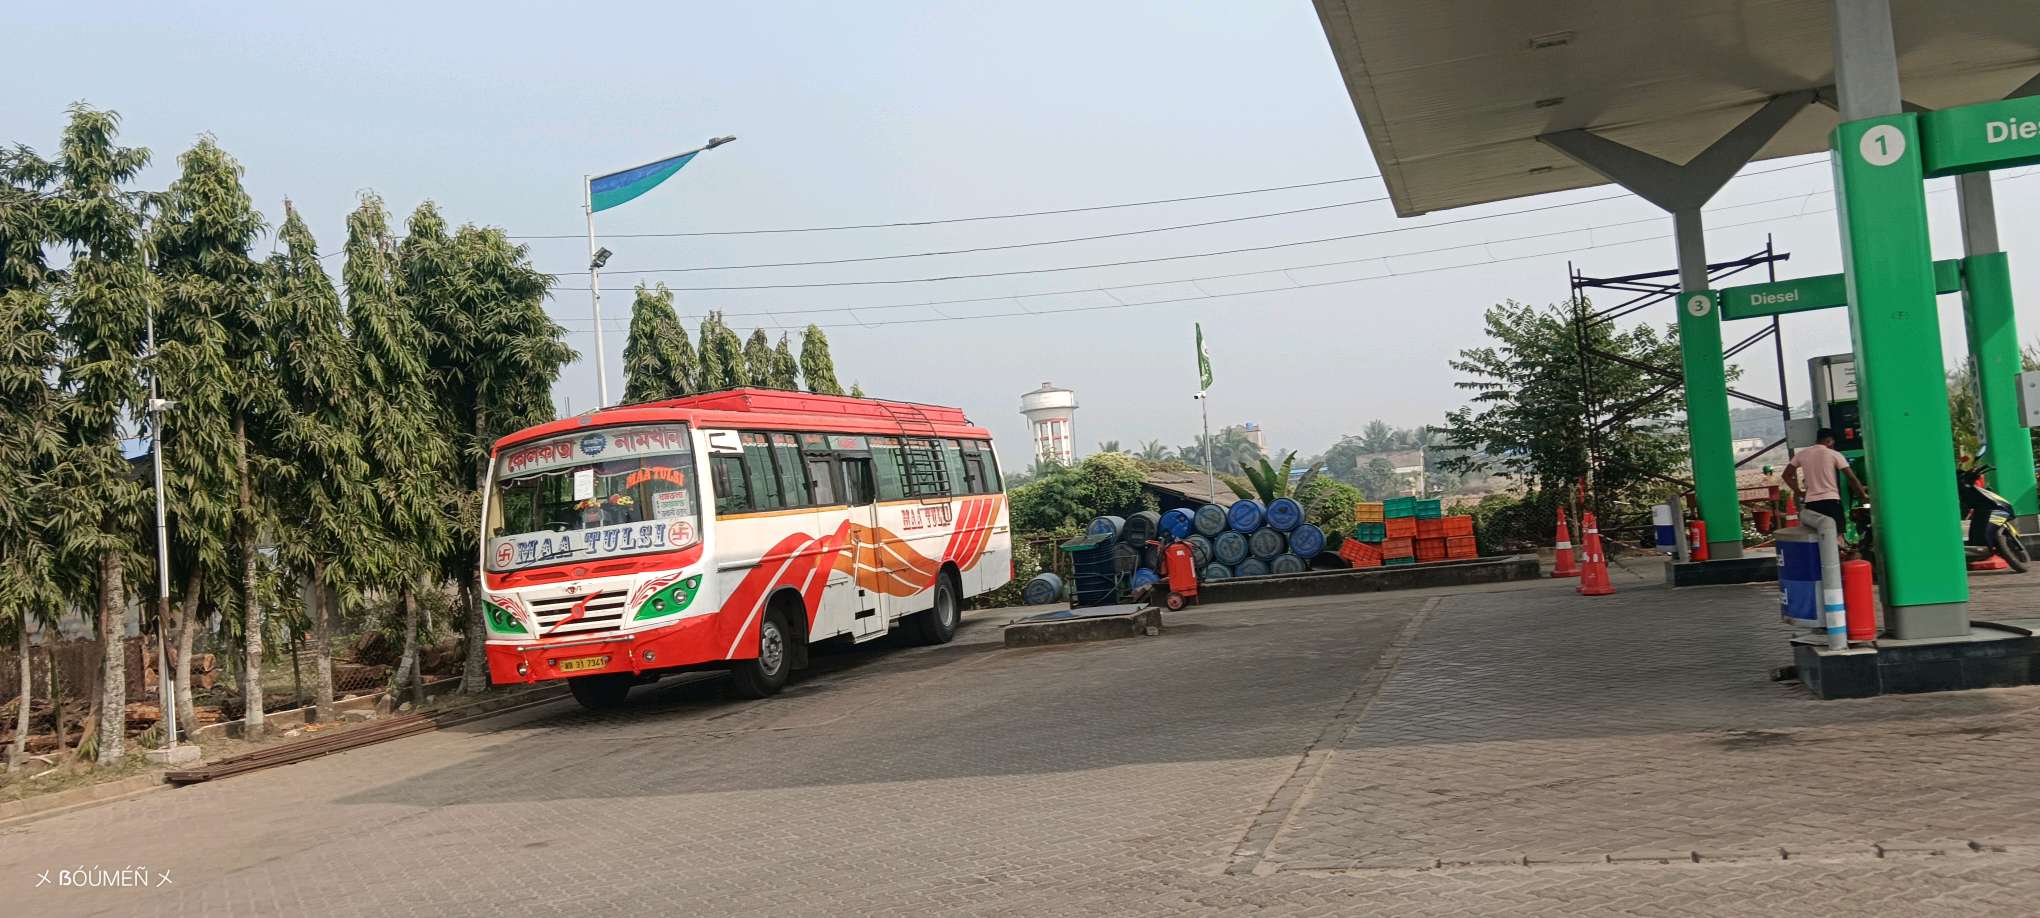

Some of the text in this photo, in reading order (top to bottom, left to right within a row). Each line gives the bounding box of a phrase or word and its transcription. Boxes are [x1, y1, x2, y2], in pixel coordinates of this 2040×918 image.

[1985, 117, 2040, 144] Die
[1874, 134, 1888, 156] 1
[1693, 300, 1704, 312] 3
[1750, 289, 1799, 306] Diesel
[626, 467, 685, 489] MAA TULSI
[902, 510, 923, 530] MAA
[516, 523, 666, 565] MAA TULSI
